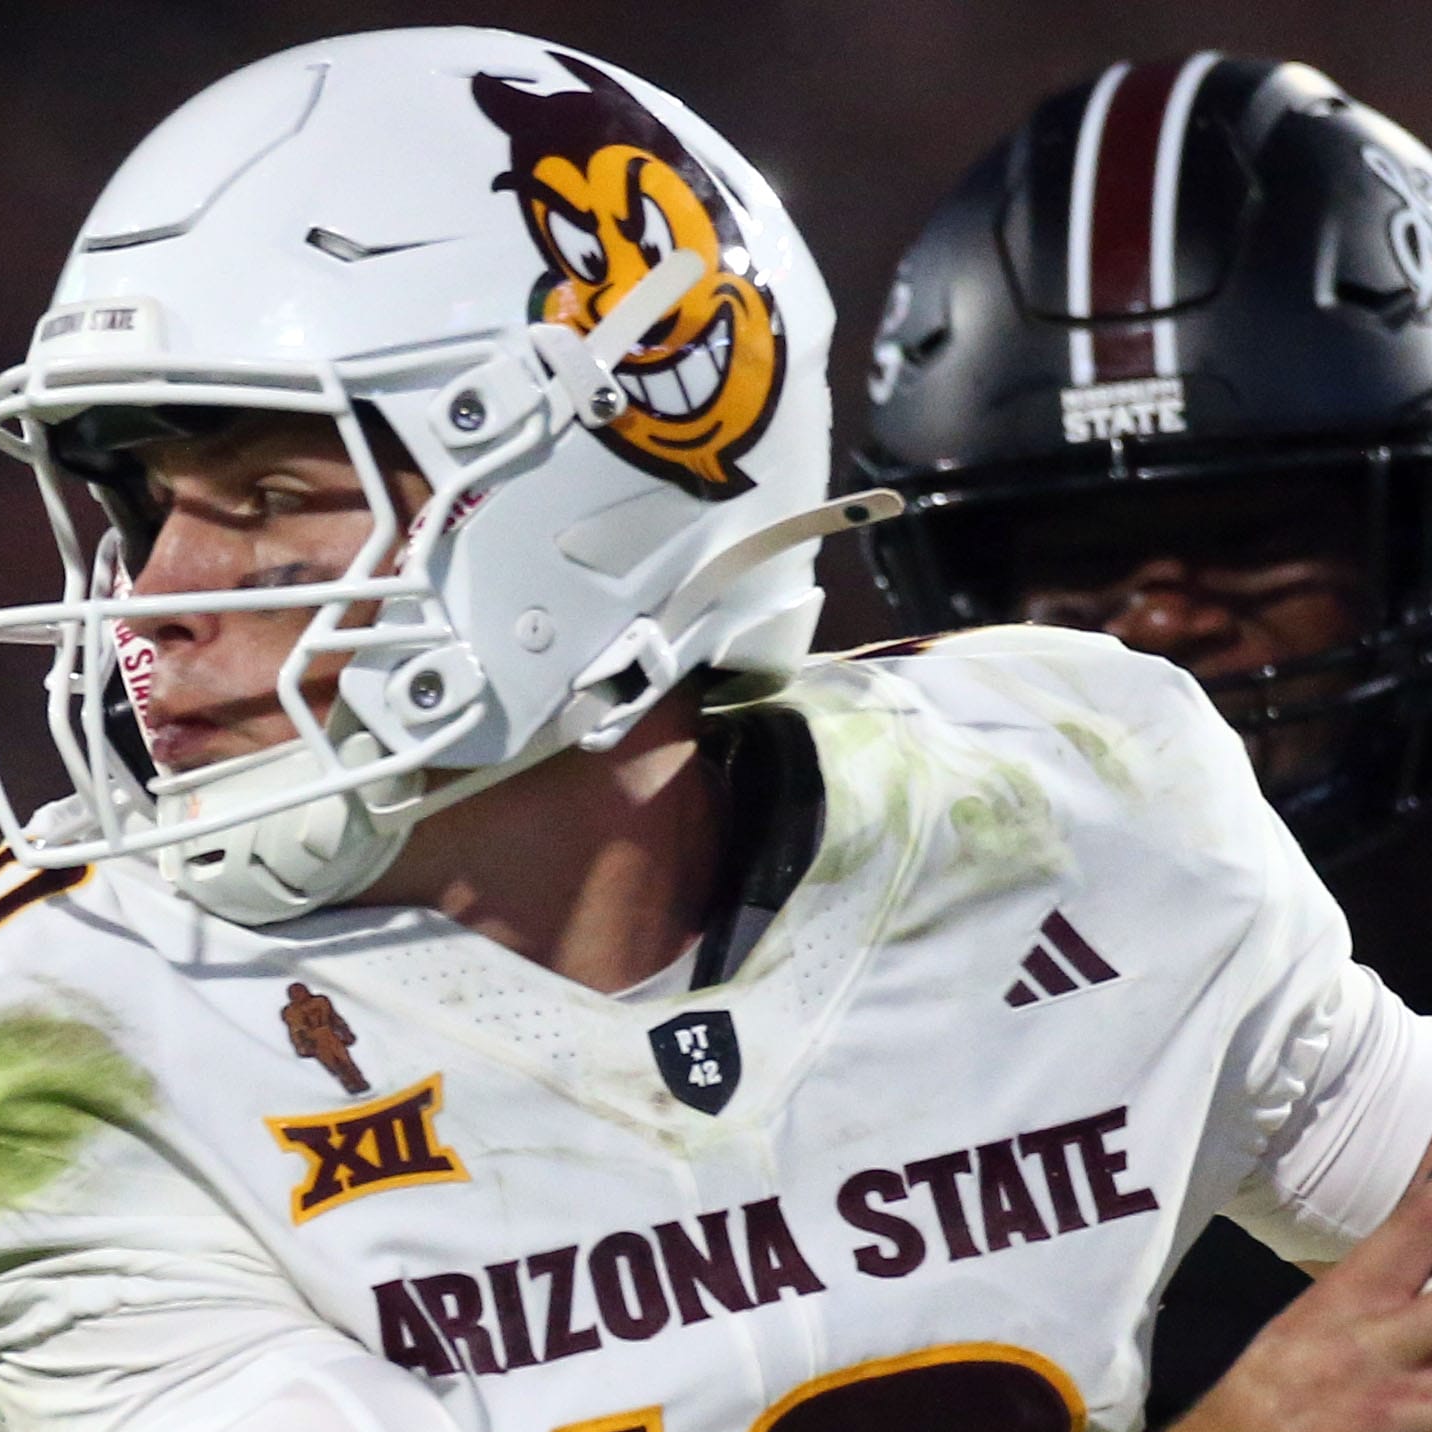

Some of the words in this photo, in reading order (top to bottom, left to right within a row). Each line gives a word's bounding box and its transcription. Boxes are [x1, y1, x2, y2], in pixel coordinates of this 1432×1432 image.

[1062, 399, 1187, 444] STATE
[674, 1024, 708, 1054] PT
[688, 1060, 722, 1087] 42
[276, 1083, 458, 1215] XII
[372, 1196, 824, 1377] ARIZONA
[836, 1105, 1159, 1278] STATE
